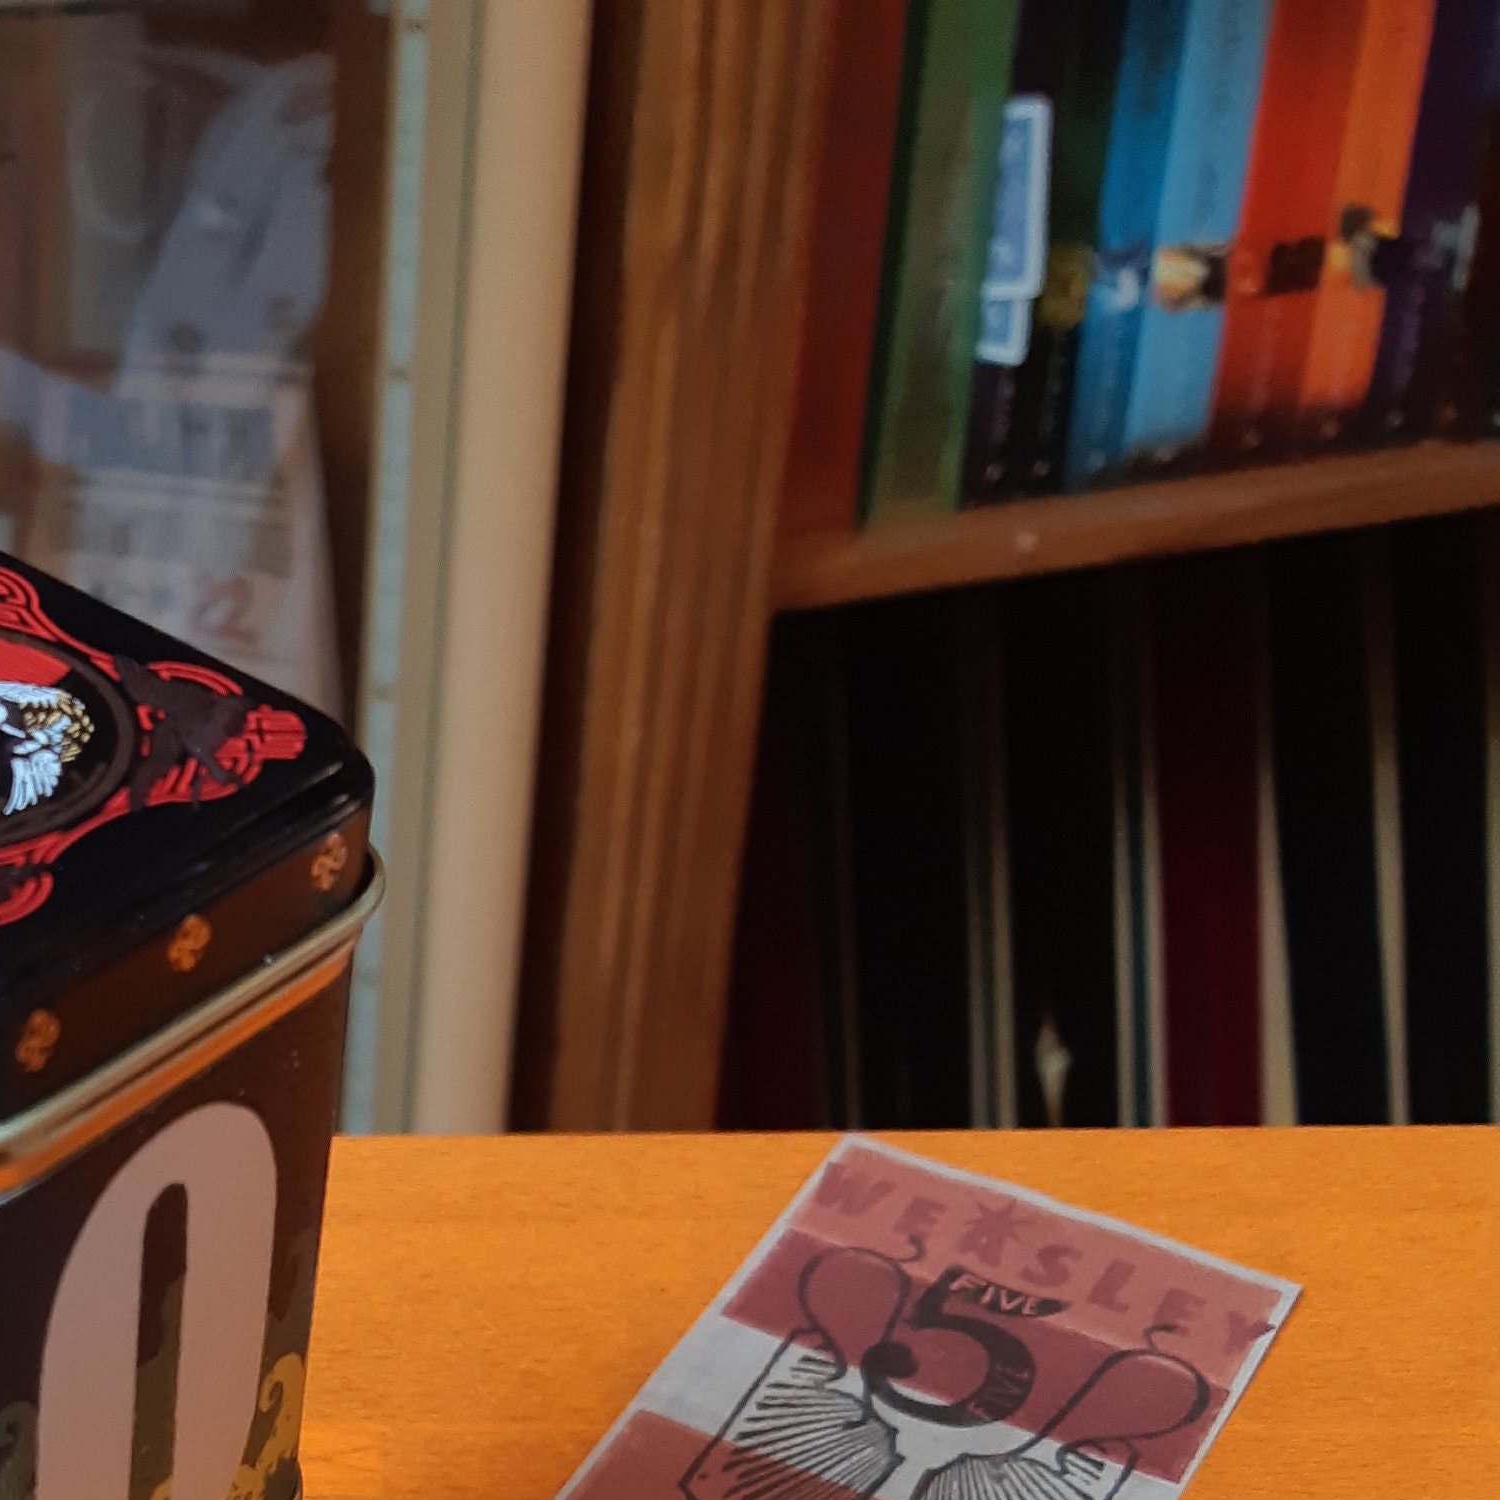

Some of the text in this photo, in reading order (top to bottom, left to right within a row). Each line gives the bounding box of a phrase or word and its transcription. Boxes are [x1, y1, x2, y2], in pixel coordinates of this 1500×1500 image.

[814, 1162, 1276, 1355] WEASLEY
[950, 1274, 1039, 1316] FIVE
[861, 1265, 1070, 1428] 5
